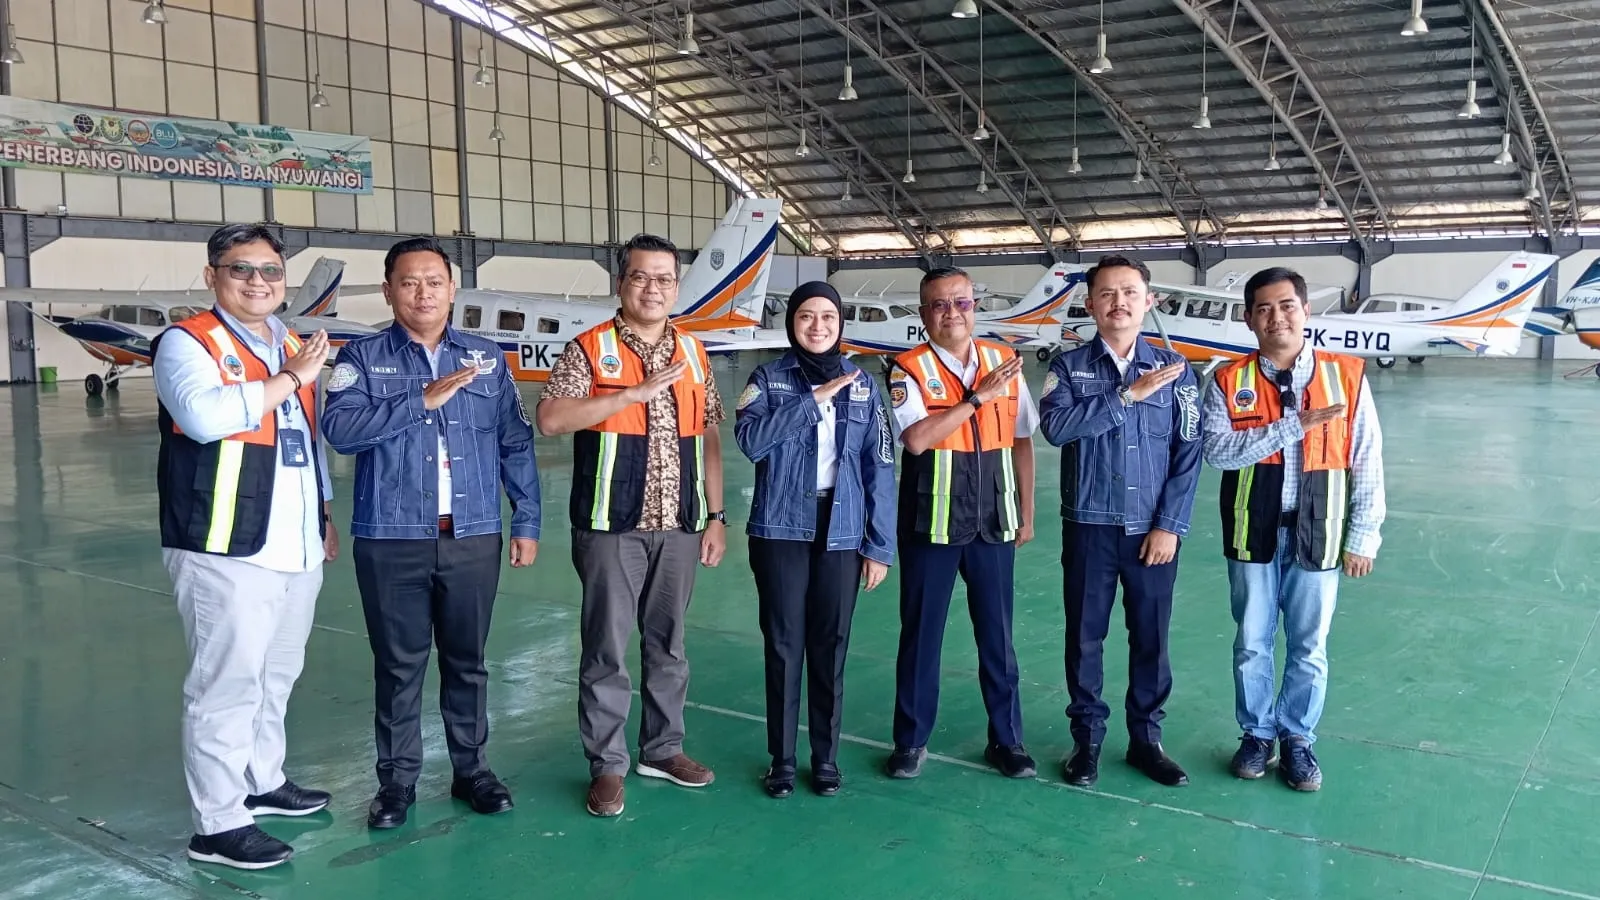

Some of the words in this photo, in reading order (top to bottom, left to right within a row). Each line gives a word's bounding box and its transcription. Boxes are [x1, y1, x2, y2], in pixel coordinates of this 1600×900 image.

[0, 142, 124, 170] ENERBANG
[127, 155, 237, 180] INDONESIA
[239, 163, 364, 189] BANYUWANGI
